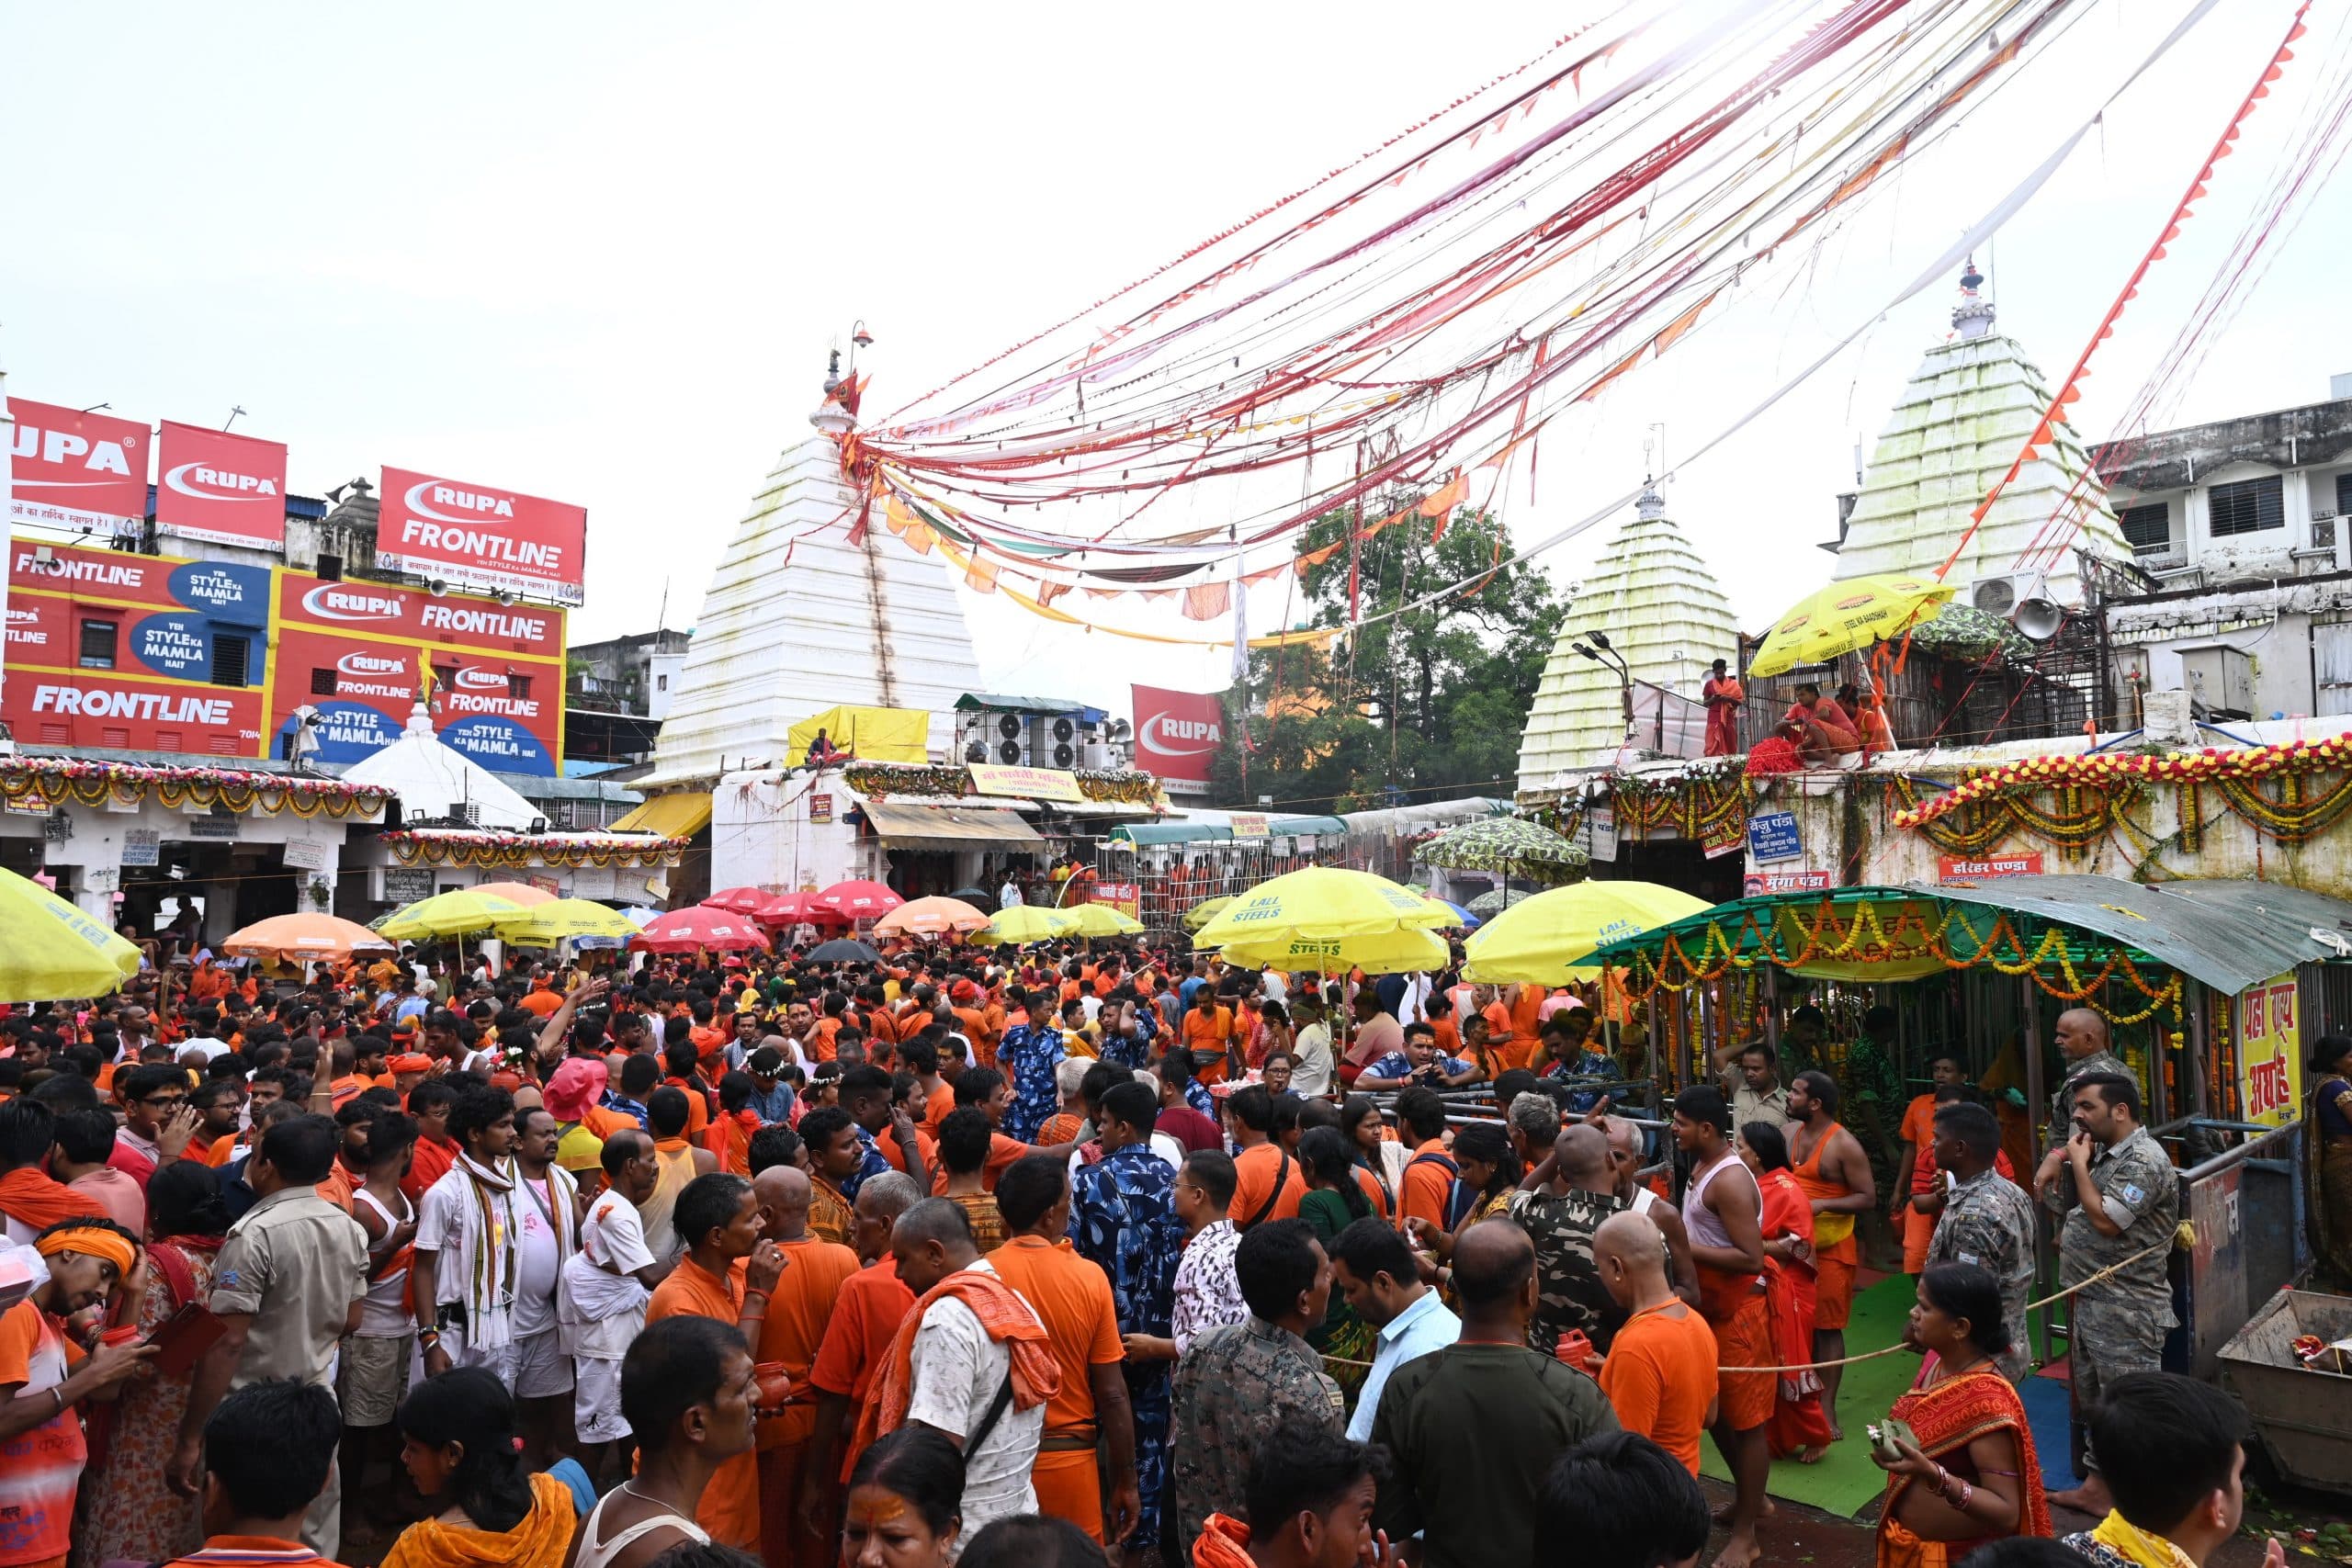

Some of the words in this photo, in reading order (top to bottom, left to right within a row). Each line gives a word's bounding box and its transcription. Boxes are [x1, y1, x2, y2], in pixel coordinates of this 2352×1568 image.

[11, 424, 131, 476] UPA
[196, 467, 277, 495] RUPA
[434, 486, 514, 517] RUPA
[41, 508, 65, 521] हार्दिक
[69, 514, 94, 525] स्वागत
[401, 519, 562, 570] FRONTLINE
[488, 560, 512, 570] STYLE
[520, 566, 548, 575] MAMLA
[190, 575, 232, 589] STYLE
[190, 586, 243, 602] MAMLA
[6, 609, 39, 622] UPA
[327, 592, 402, 616] RUPA
[421, 604, 546, 641] FRONTLINE
[168, 622, 184, 631] YEH
[6, 629, 48, 644] TLINE
[145, 629, 191, 646] STYLE
[190, 637, 203, 648] KA
[143, 643, 204, 661] MAMLA
[352, 656, 404, 673] RUPA
[467, 671, 509, 686] RUPA
[336, 681, 411, 698] FRONTLINE
[31, 684, 233, 725] FRONTLINE
[449, 693, 539, 716] FRONTLINE
[334, 710, 379, 728] STYLE
[328, 727, 384, 745] MAMLA
[472, 725, 513, 739] STYLE
[1161, 717, 1221, 742] RUPA
[454, 737, 467, 745] KA
[467, 739, 518, 756] MAMLA
[1771, 815, 1793, 828] पंडा
[1951, 861, 1990, 874] हरिहर
[1992, 861, 2028, 872] पण्डा
[1249, 896, 1280, 908] LALL
[1232, 908, 1282, 922] STEELS
[1600, 919, 1627, 936] LALL
